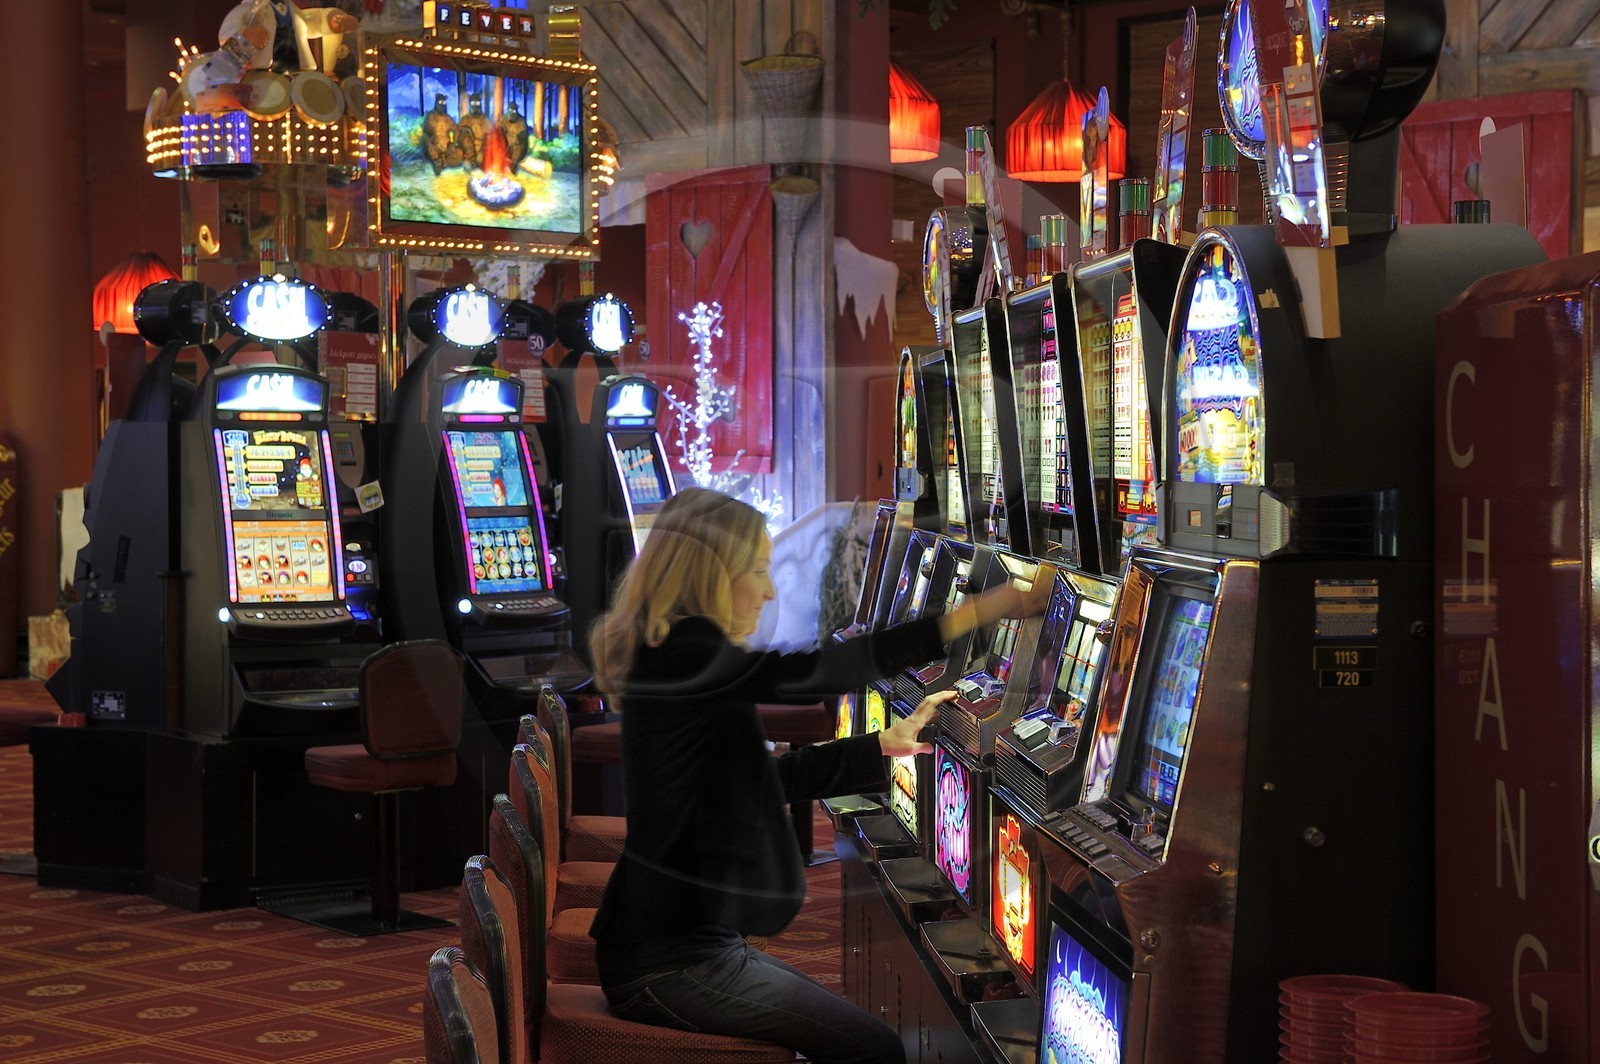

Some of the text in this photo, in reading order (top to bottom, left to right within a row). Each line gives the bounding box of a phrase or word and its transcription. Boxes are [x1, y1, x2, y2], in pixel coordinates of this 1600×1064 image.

[440, 8, 531, 32] FEVER
[530, 335, 544, 350] 50
[1334, 651, 1359, 665] 1113
[1336, 671, 1360, 686] 720
